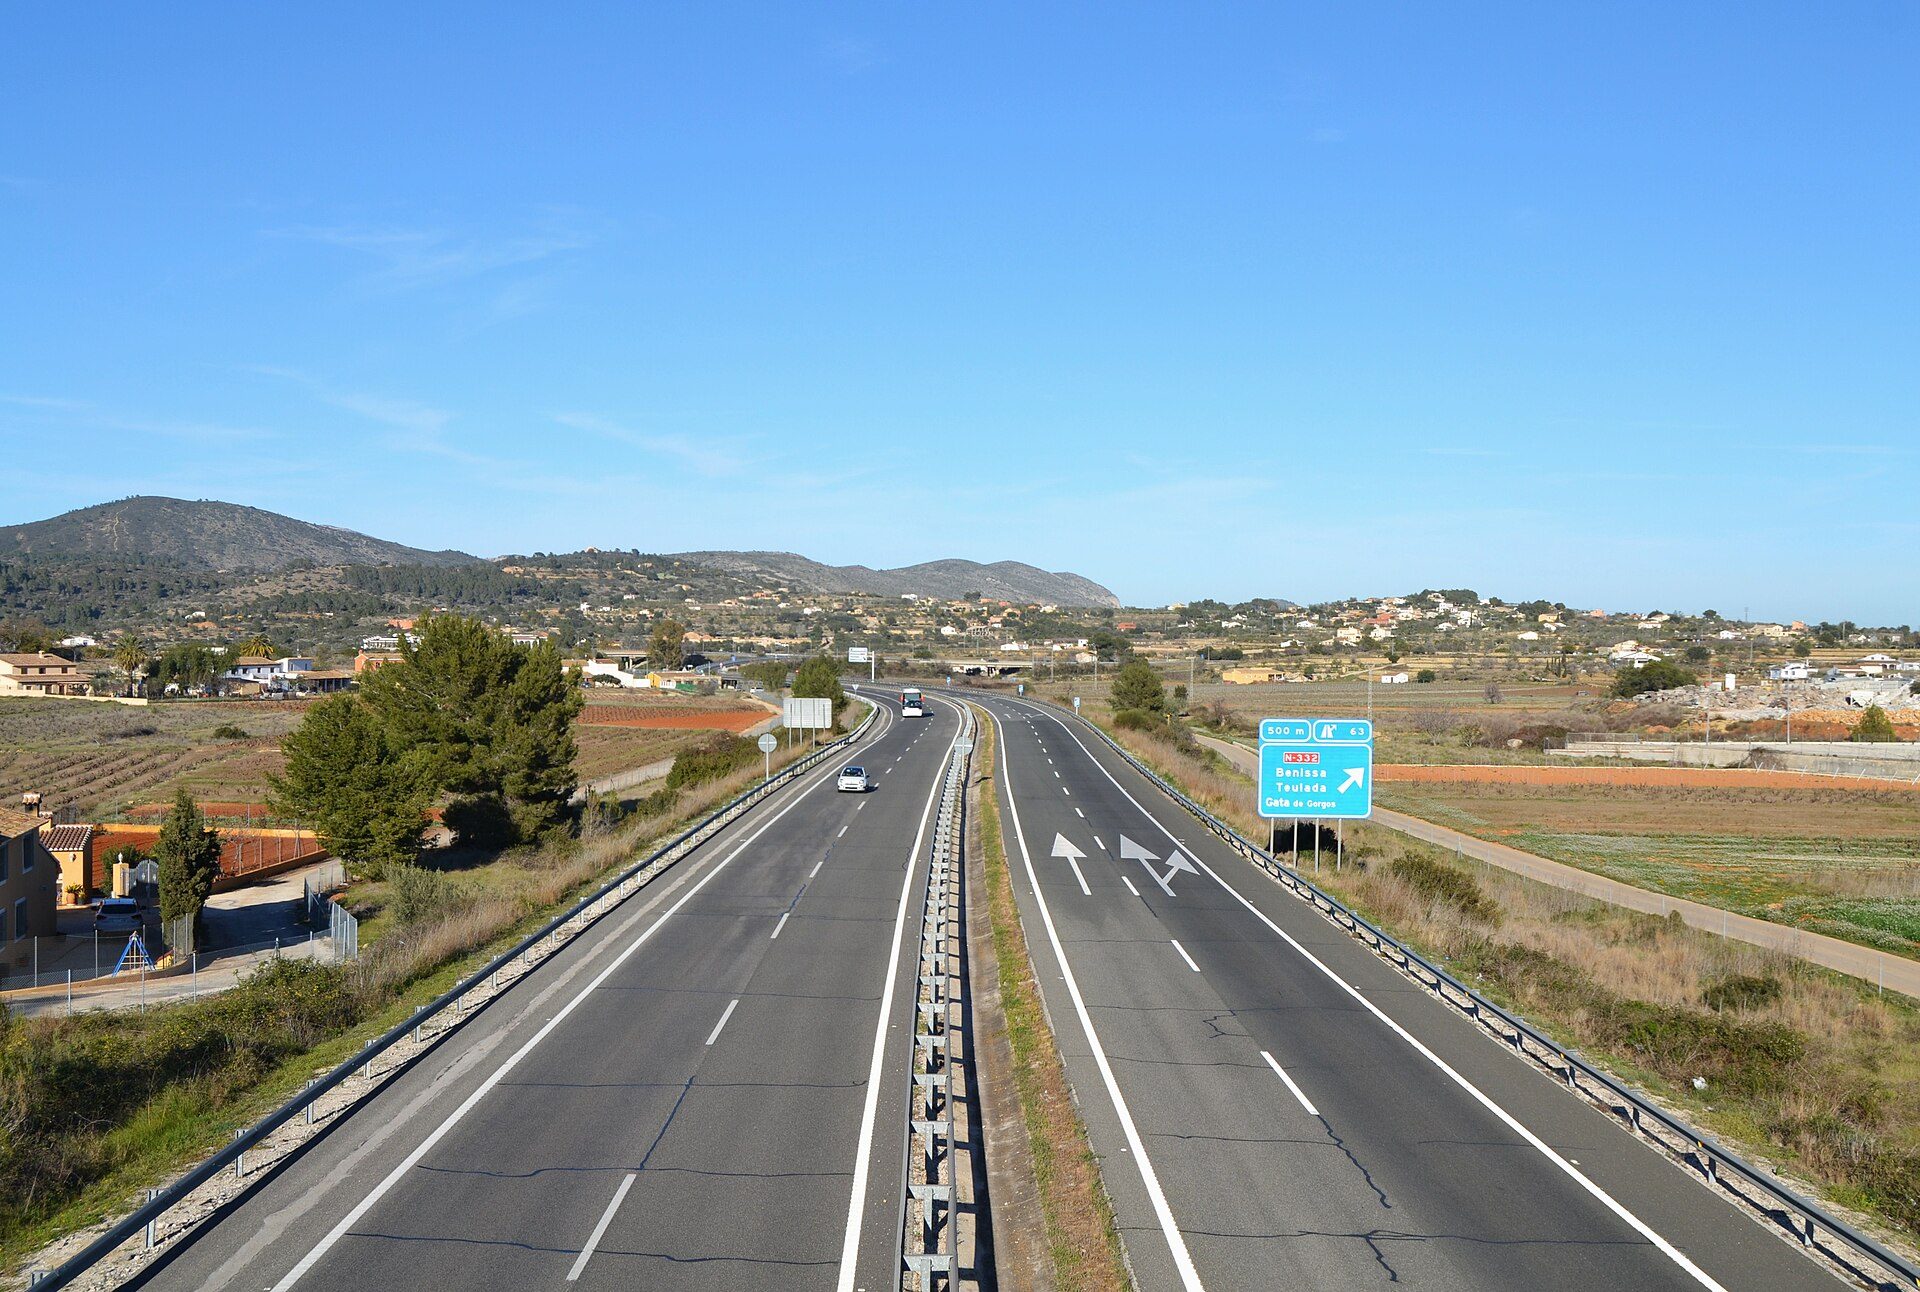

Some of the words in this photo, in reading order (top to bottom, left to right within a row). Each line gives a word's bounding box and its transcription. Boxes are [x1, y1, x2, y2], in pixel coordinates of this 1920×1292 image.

[1267, 727, 1290, 735] 500
[1285, 753, 1318, 762] N-332
[1275, 767, 1327, 778] Benissa
[1276, 782, 1327, 793] Teulada
[1265, 797, 1290, 808] Gata
[1307, 800, 1336, 810] Gorgos
